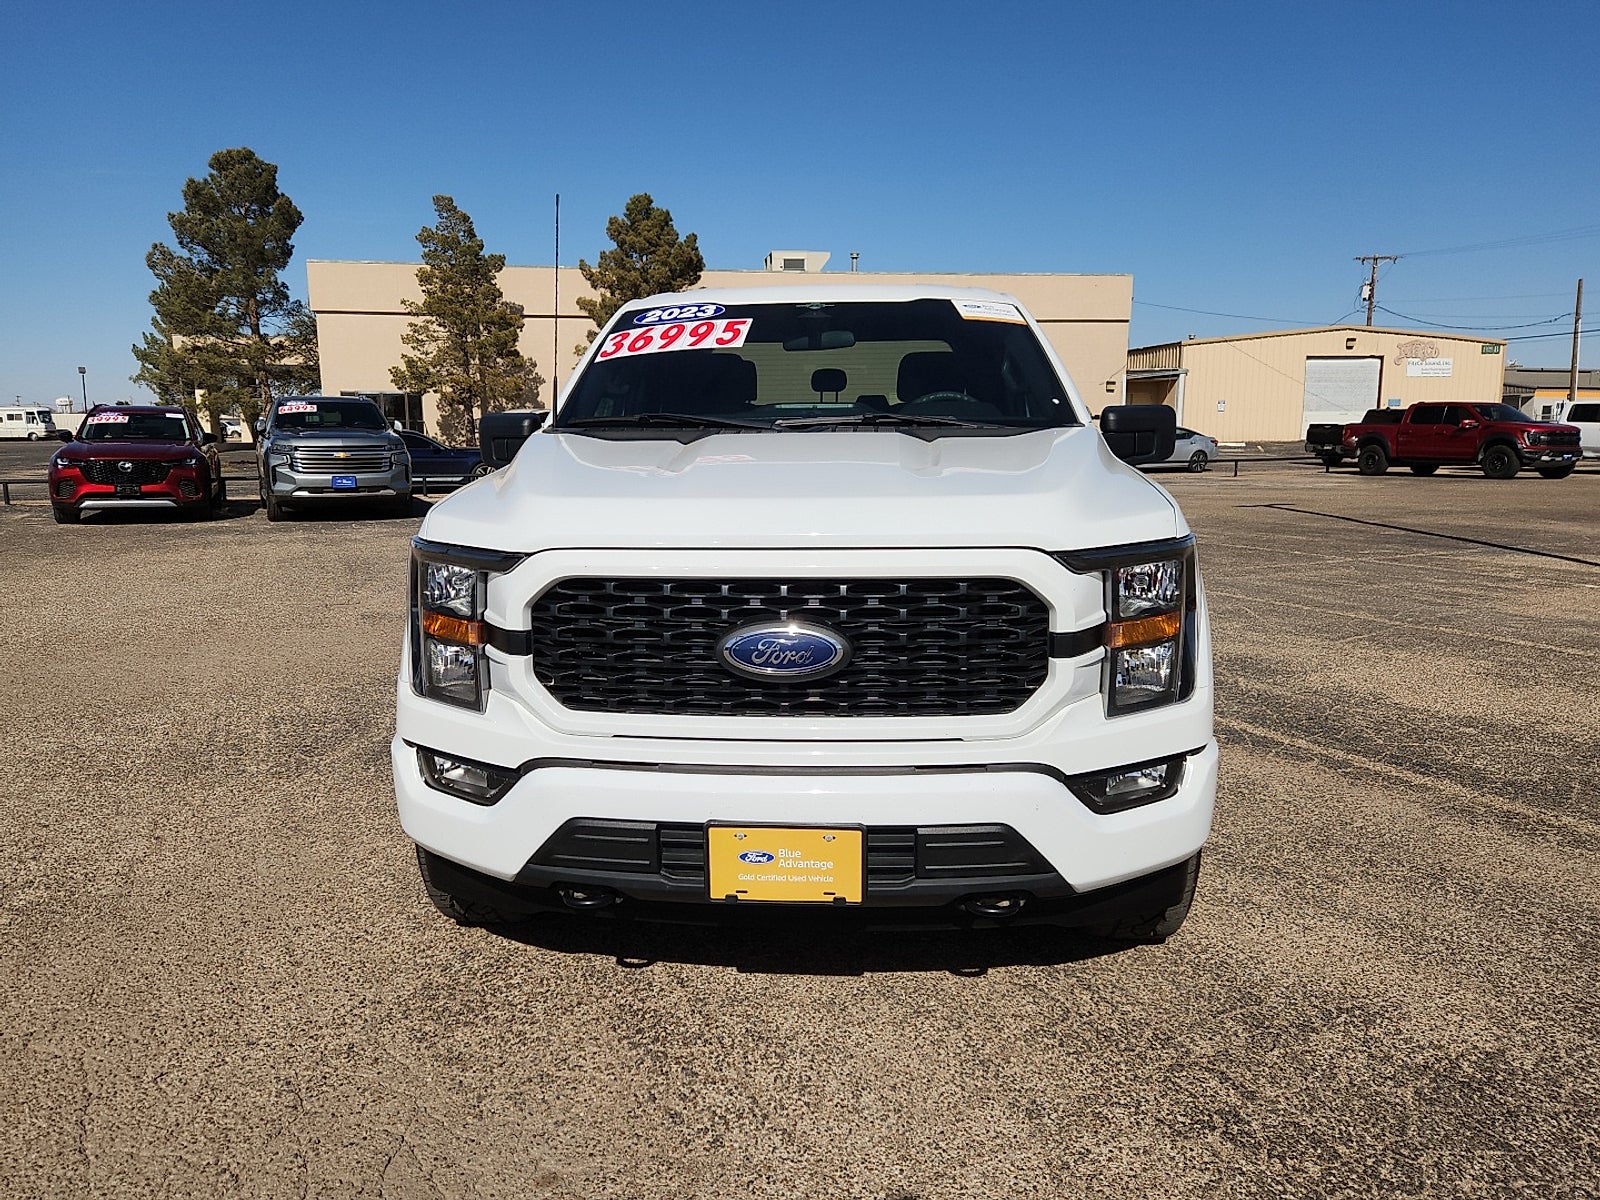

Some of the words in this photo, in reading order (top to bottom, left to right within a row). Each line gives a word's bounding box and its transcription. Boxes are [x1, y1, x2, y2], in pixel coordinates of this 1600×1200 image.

[644, 304, 717, 322] 2023
[600, 320, 748, 358] 36995
[751, 638, 815, 665] Ford
[744, 851, 769, 863] Ford
[777, 848, 802, 858] Blue
[777, 859, 834, 871] Advantage
[737, 873, 755, 881] Gold
[756, 873, 787, 882] Certified
[789, 874, 807, 882] Used
[808, 874, 834, 883] Vehicle
